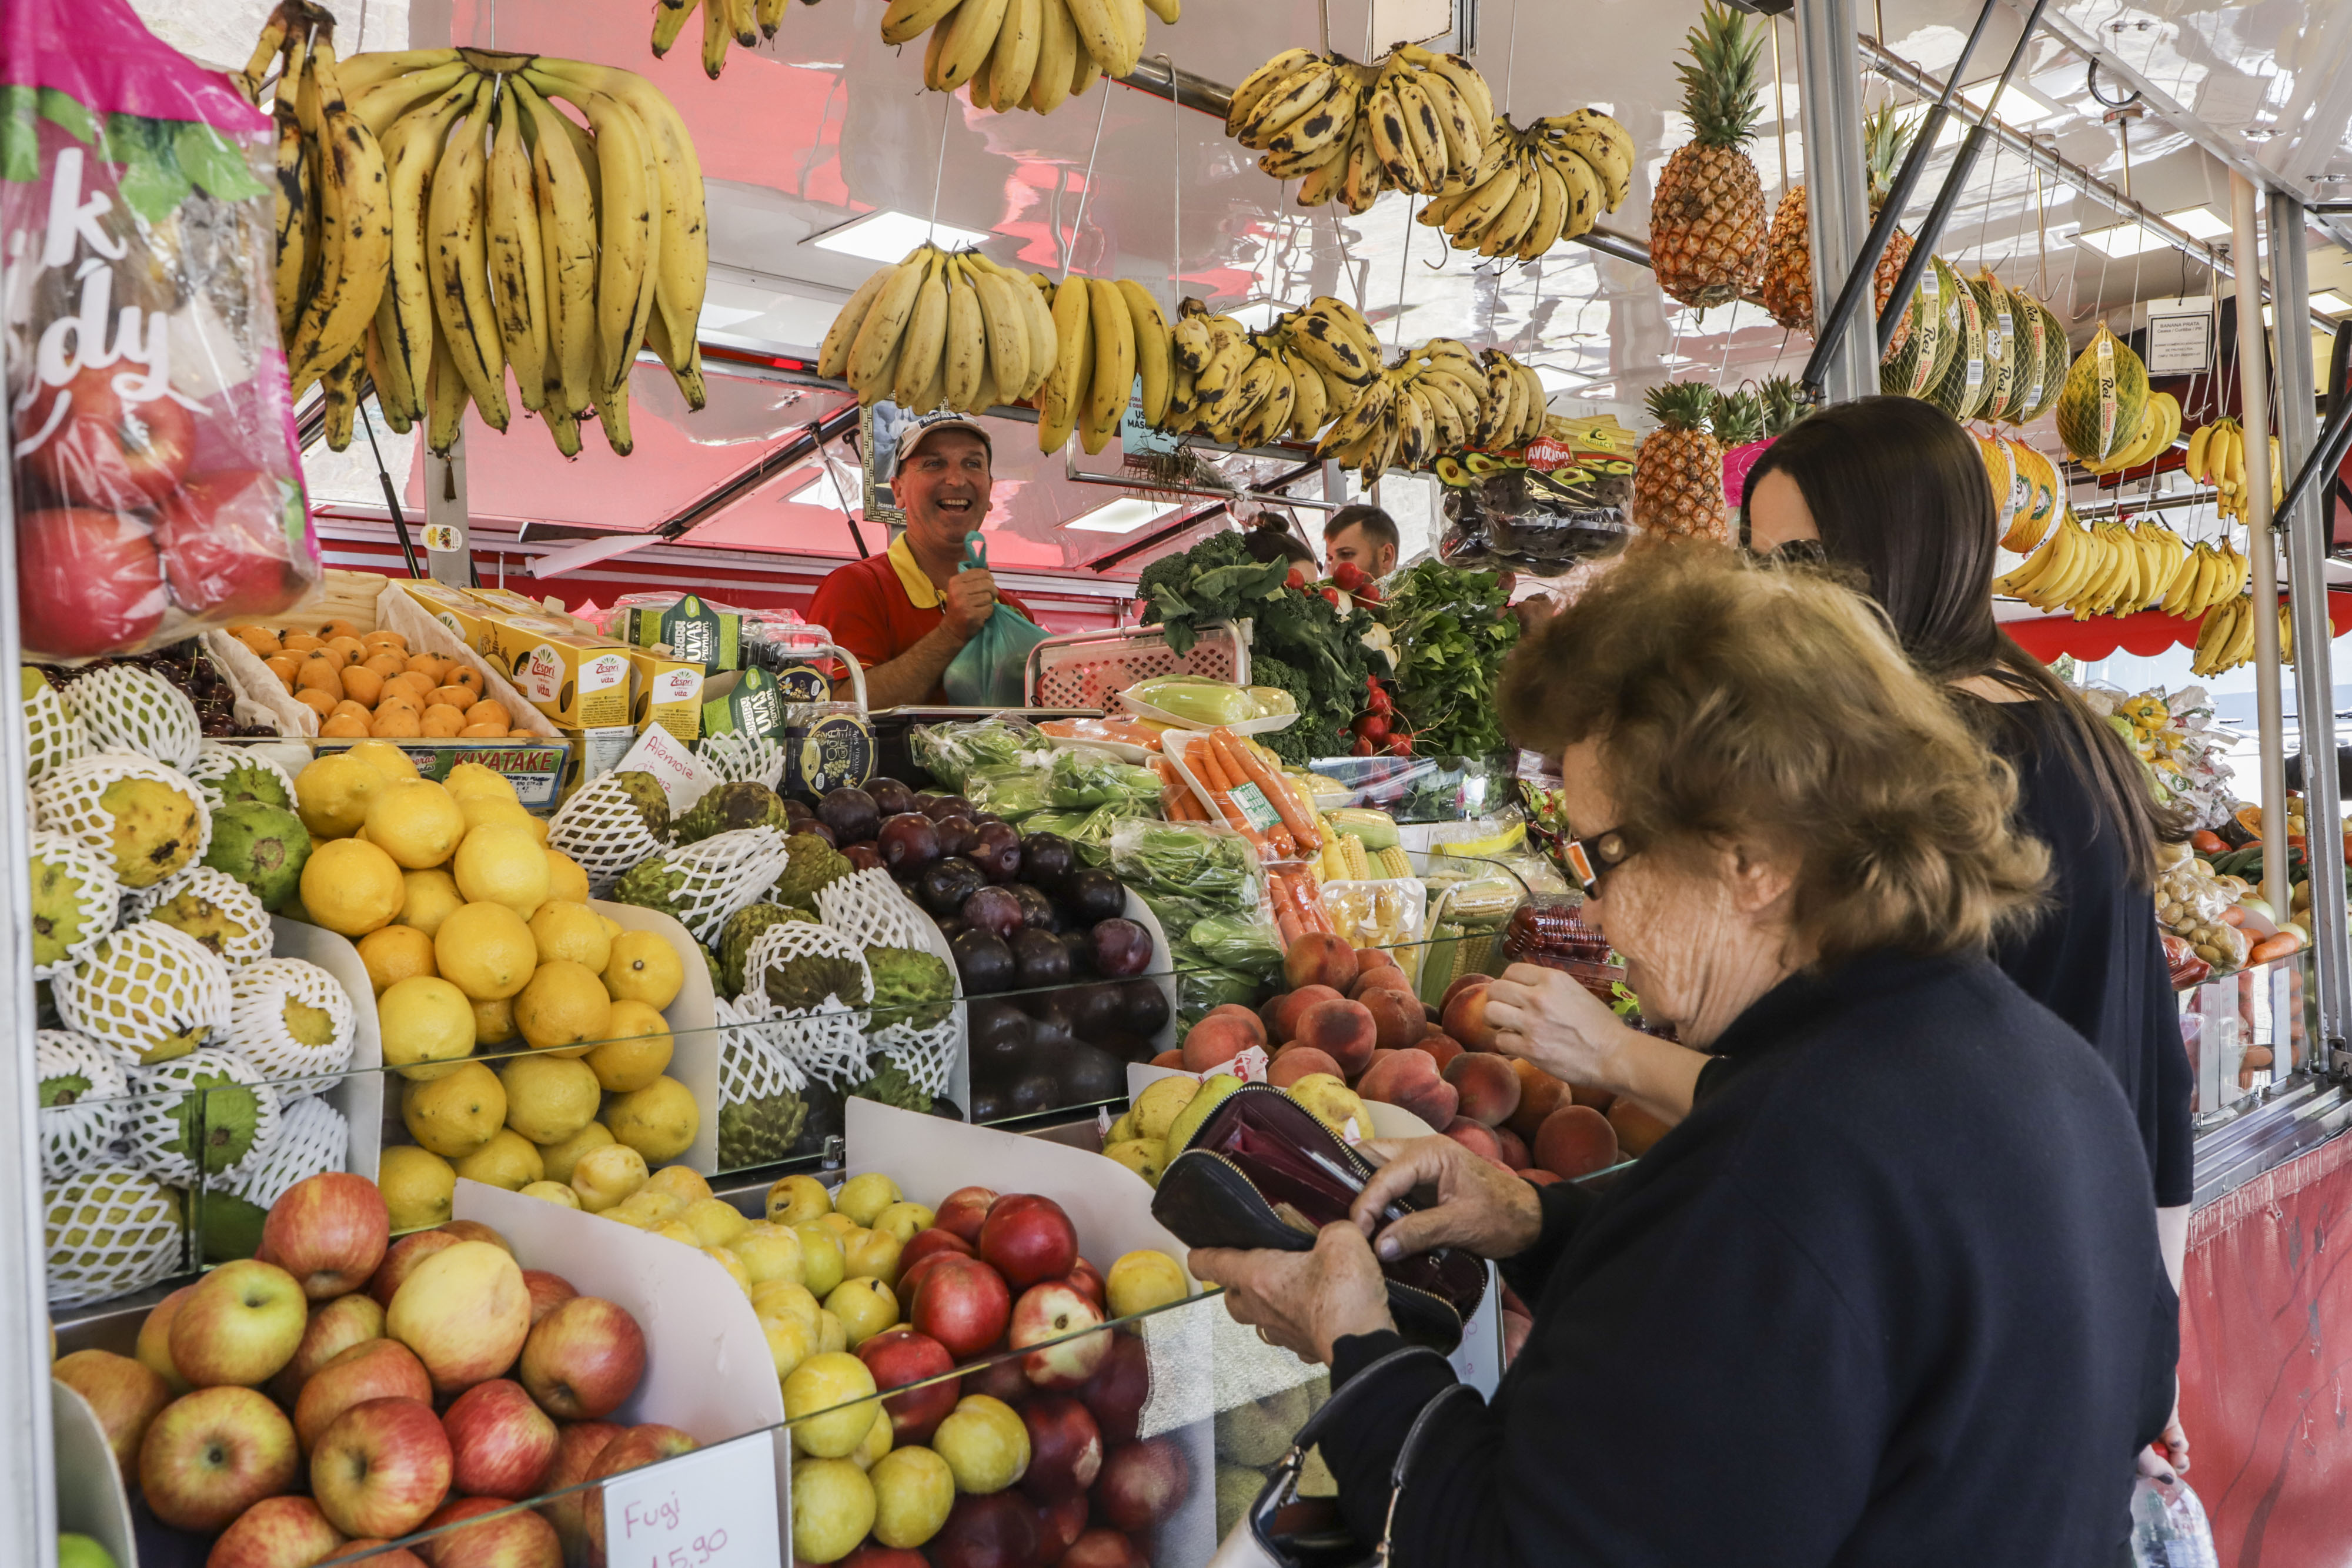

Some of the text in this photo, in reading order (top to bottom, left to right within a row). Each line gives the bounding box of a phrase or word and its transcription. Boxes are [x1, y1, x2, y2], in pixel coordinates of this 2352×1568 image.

[1966, 300, 1976, 330] SABOROSO
[2025, 305, 2038, 324] Rei
[1921, 327, 1936, 355] Rei
[1997, 366, 2011, 393] Rei
[2102, 377, 2113, 400] Rei
[686, 620, 703, 661] UVAS
[532, 656, 555, 679] Zespri
[596, 663, 619, 674] Zespri
[537, 684, 551, 697] vita
[670, 676, 694, 687] Zespri
[751, 691, 773, 734] UVAS
[766, 688, 779, 728] premium
[413, 755, 436, 765] eras
[453, 752, 554, 772] KIYATAKE
[624, 1490, 680, 1539] Fugi
